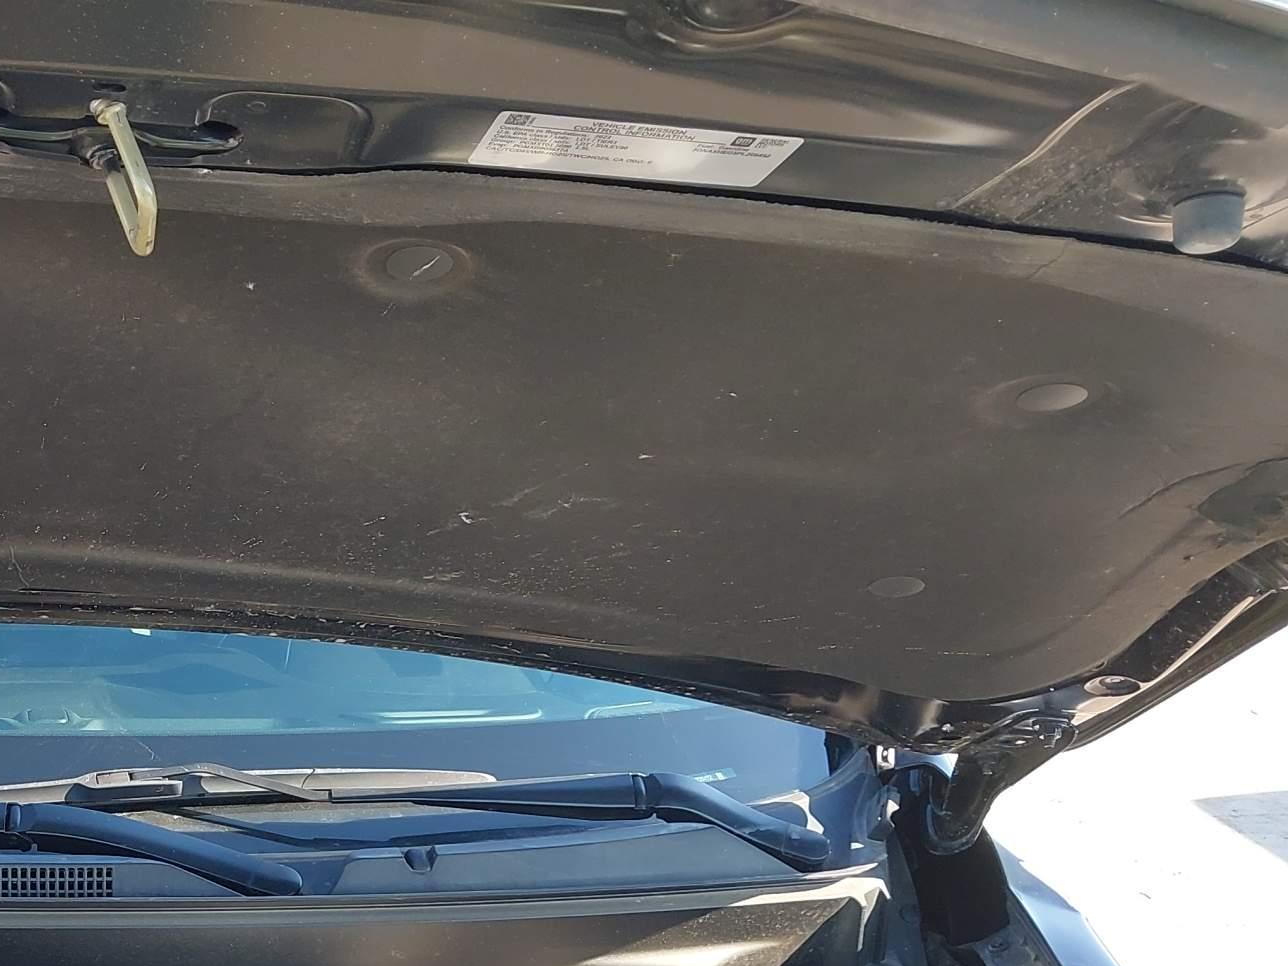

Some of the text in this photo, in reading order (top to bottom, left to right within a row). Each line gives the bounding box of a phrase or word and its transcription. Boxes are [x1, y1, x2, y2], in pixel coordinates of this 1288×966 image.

[573, 125, 696, 140] CONTROL INFORMATION
[591, 122, 688, 134] VEHICLE EMISSION
